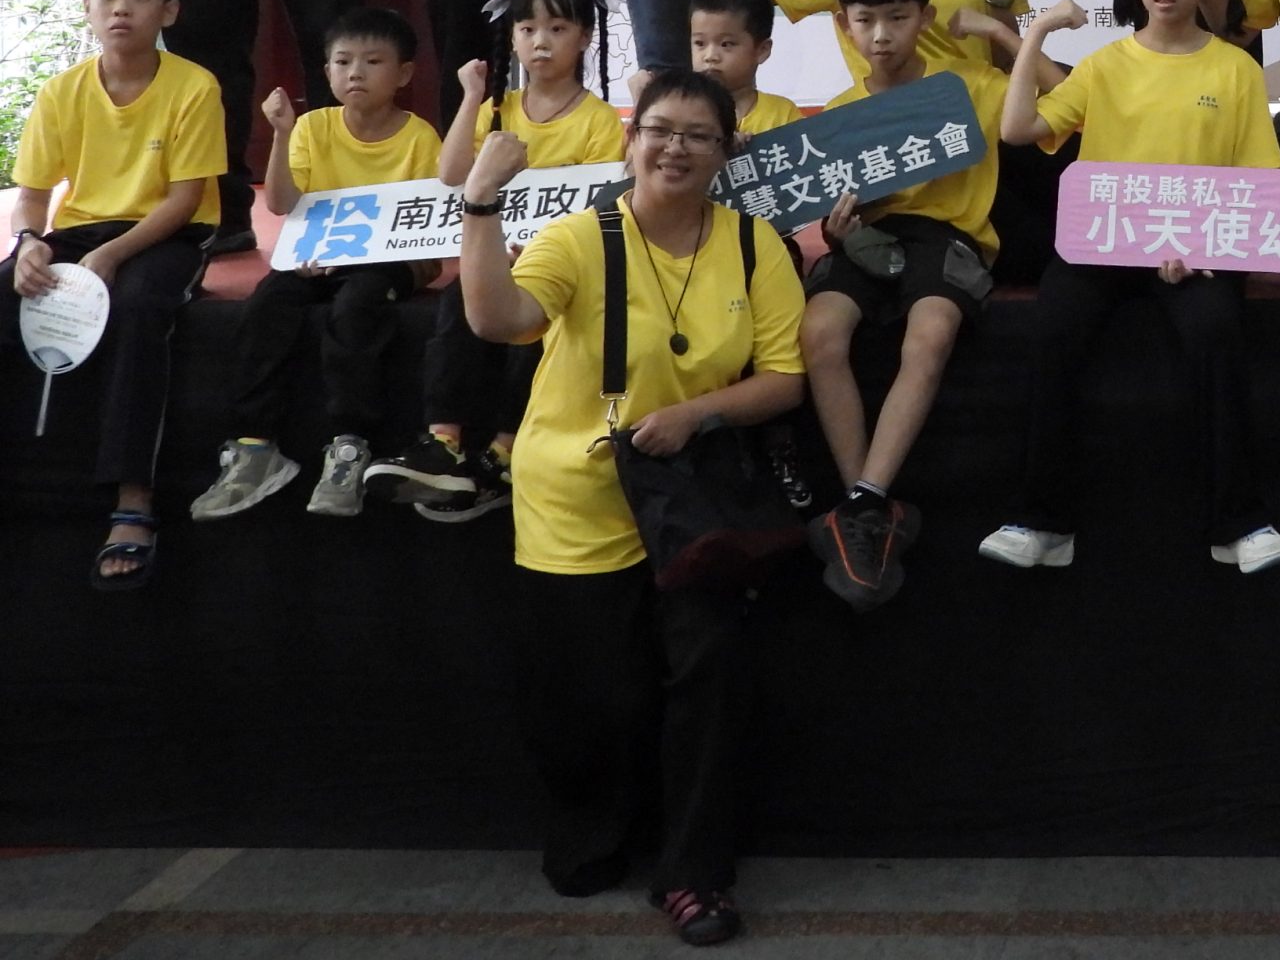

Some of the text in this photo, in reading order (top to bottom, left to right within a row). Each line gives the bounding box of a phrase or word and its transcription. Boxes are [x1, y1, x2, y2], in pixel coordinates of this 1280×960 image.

[721, 121, 971, 220] 慧文教基金會
[1089, 172, 1257, 209] 南投縣私立
[385, 234, 446, 249] Nantou
